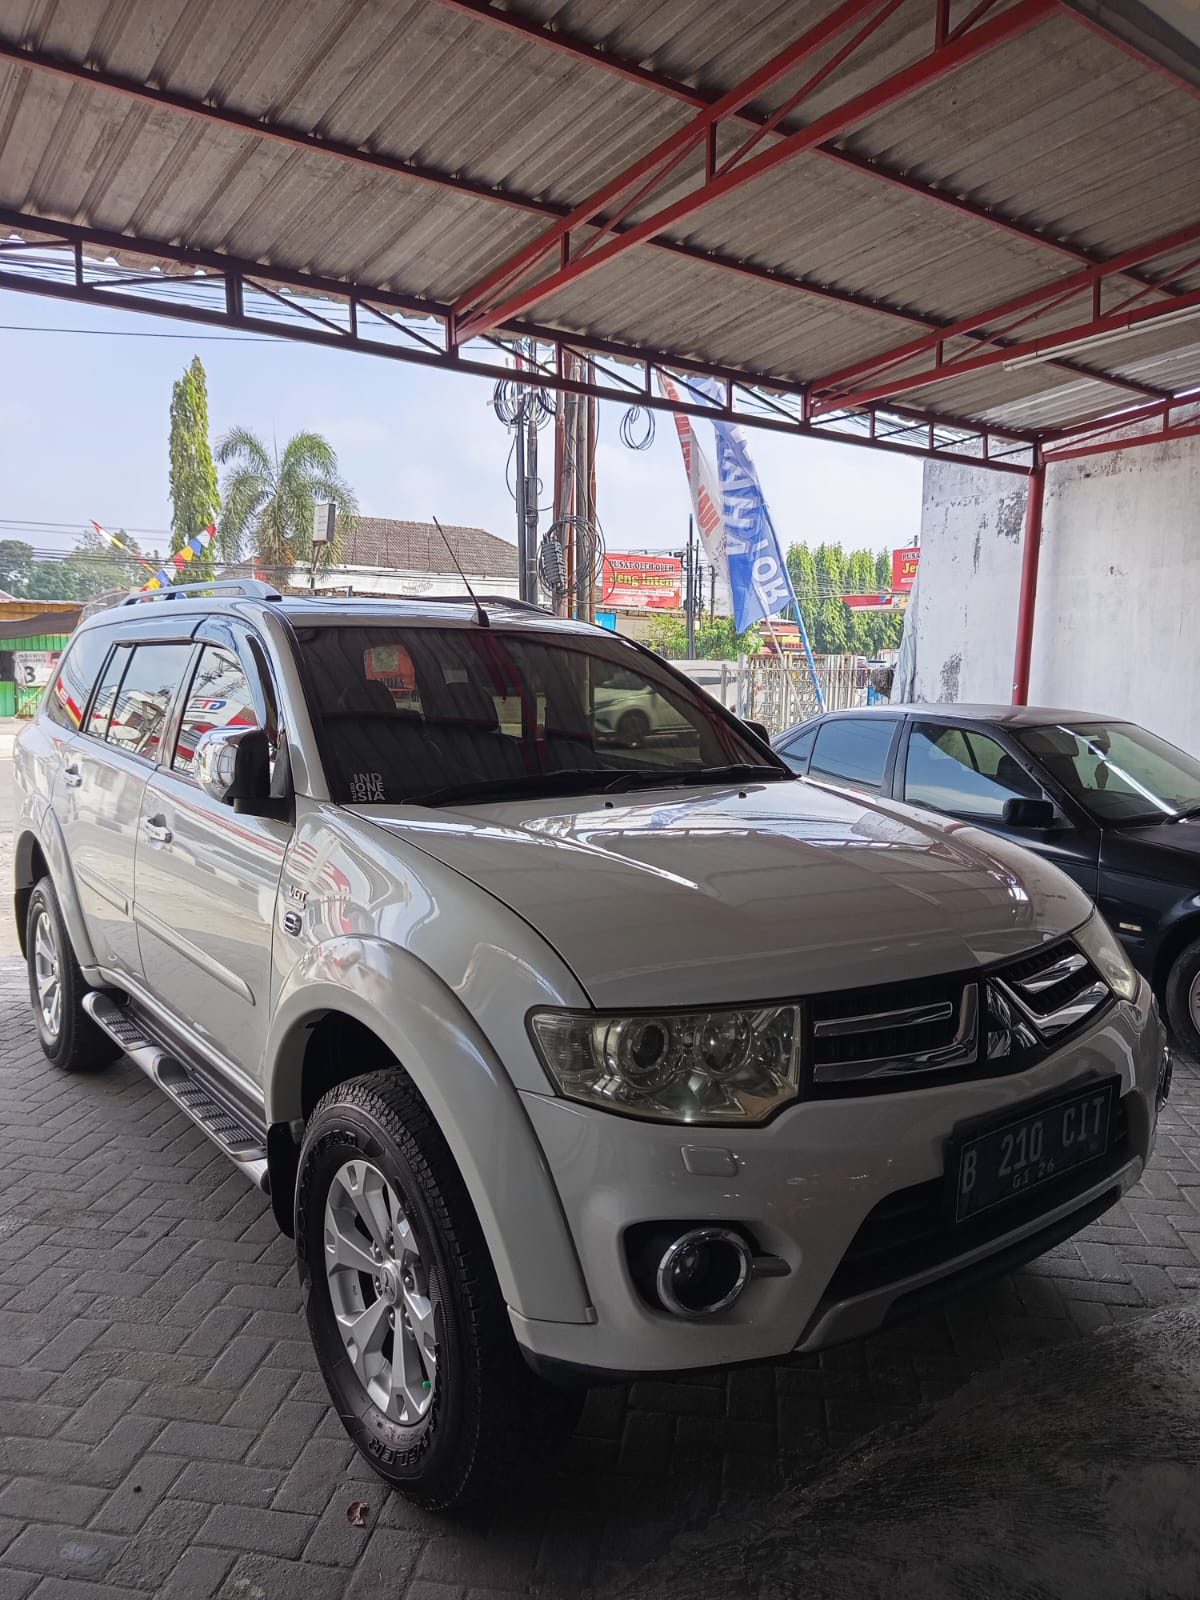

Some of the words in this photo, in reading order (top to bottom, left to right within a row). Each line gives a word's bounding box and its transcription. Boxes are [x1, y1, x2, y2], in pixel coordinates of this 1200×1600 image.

[609, 560, 634, 570] PUSAT
[635, 562, 655, 571] OLEH
[655, 564, 674, 573] OLEH
[609, 571, 639, 588] Jeng
[641, 573, 674, 587] Inten
[353, 772, 382, 783] IND
[355, 782, 385, 792] ONE
[357, 791, 386, 801] SIA
[290, 885, 309, 902] VGT
[961, 1150, 976, 1194] B
[999, 1121, 1043, 1176] 210
[1062, 1097, 1105, 1147] CIT
